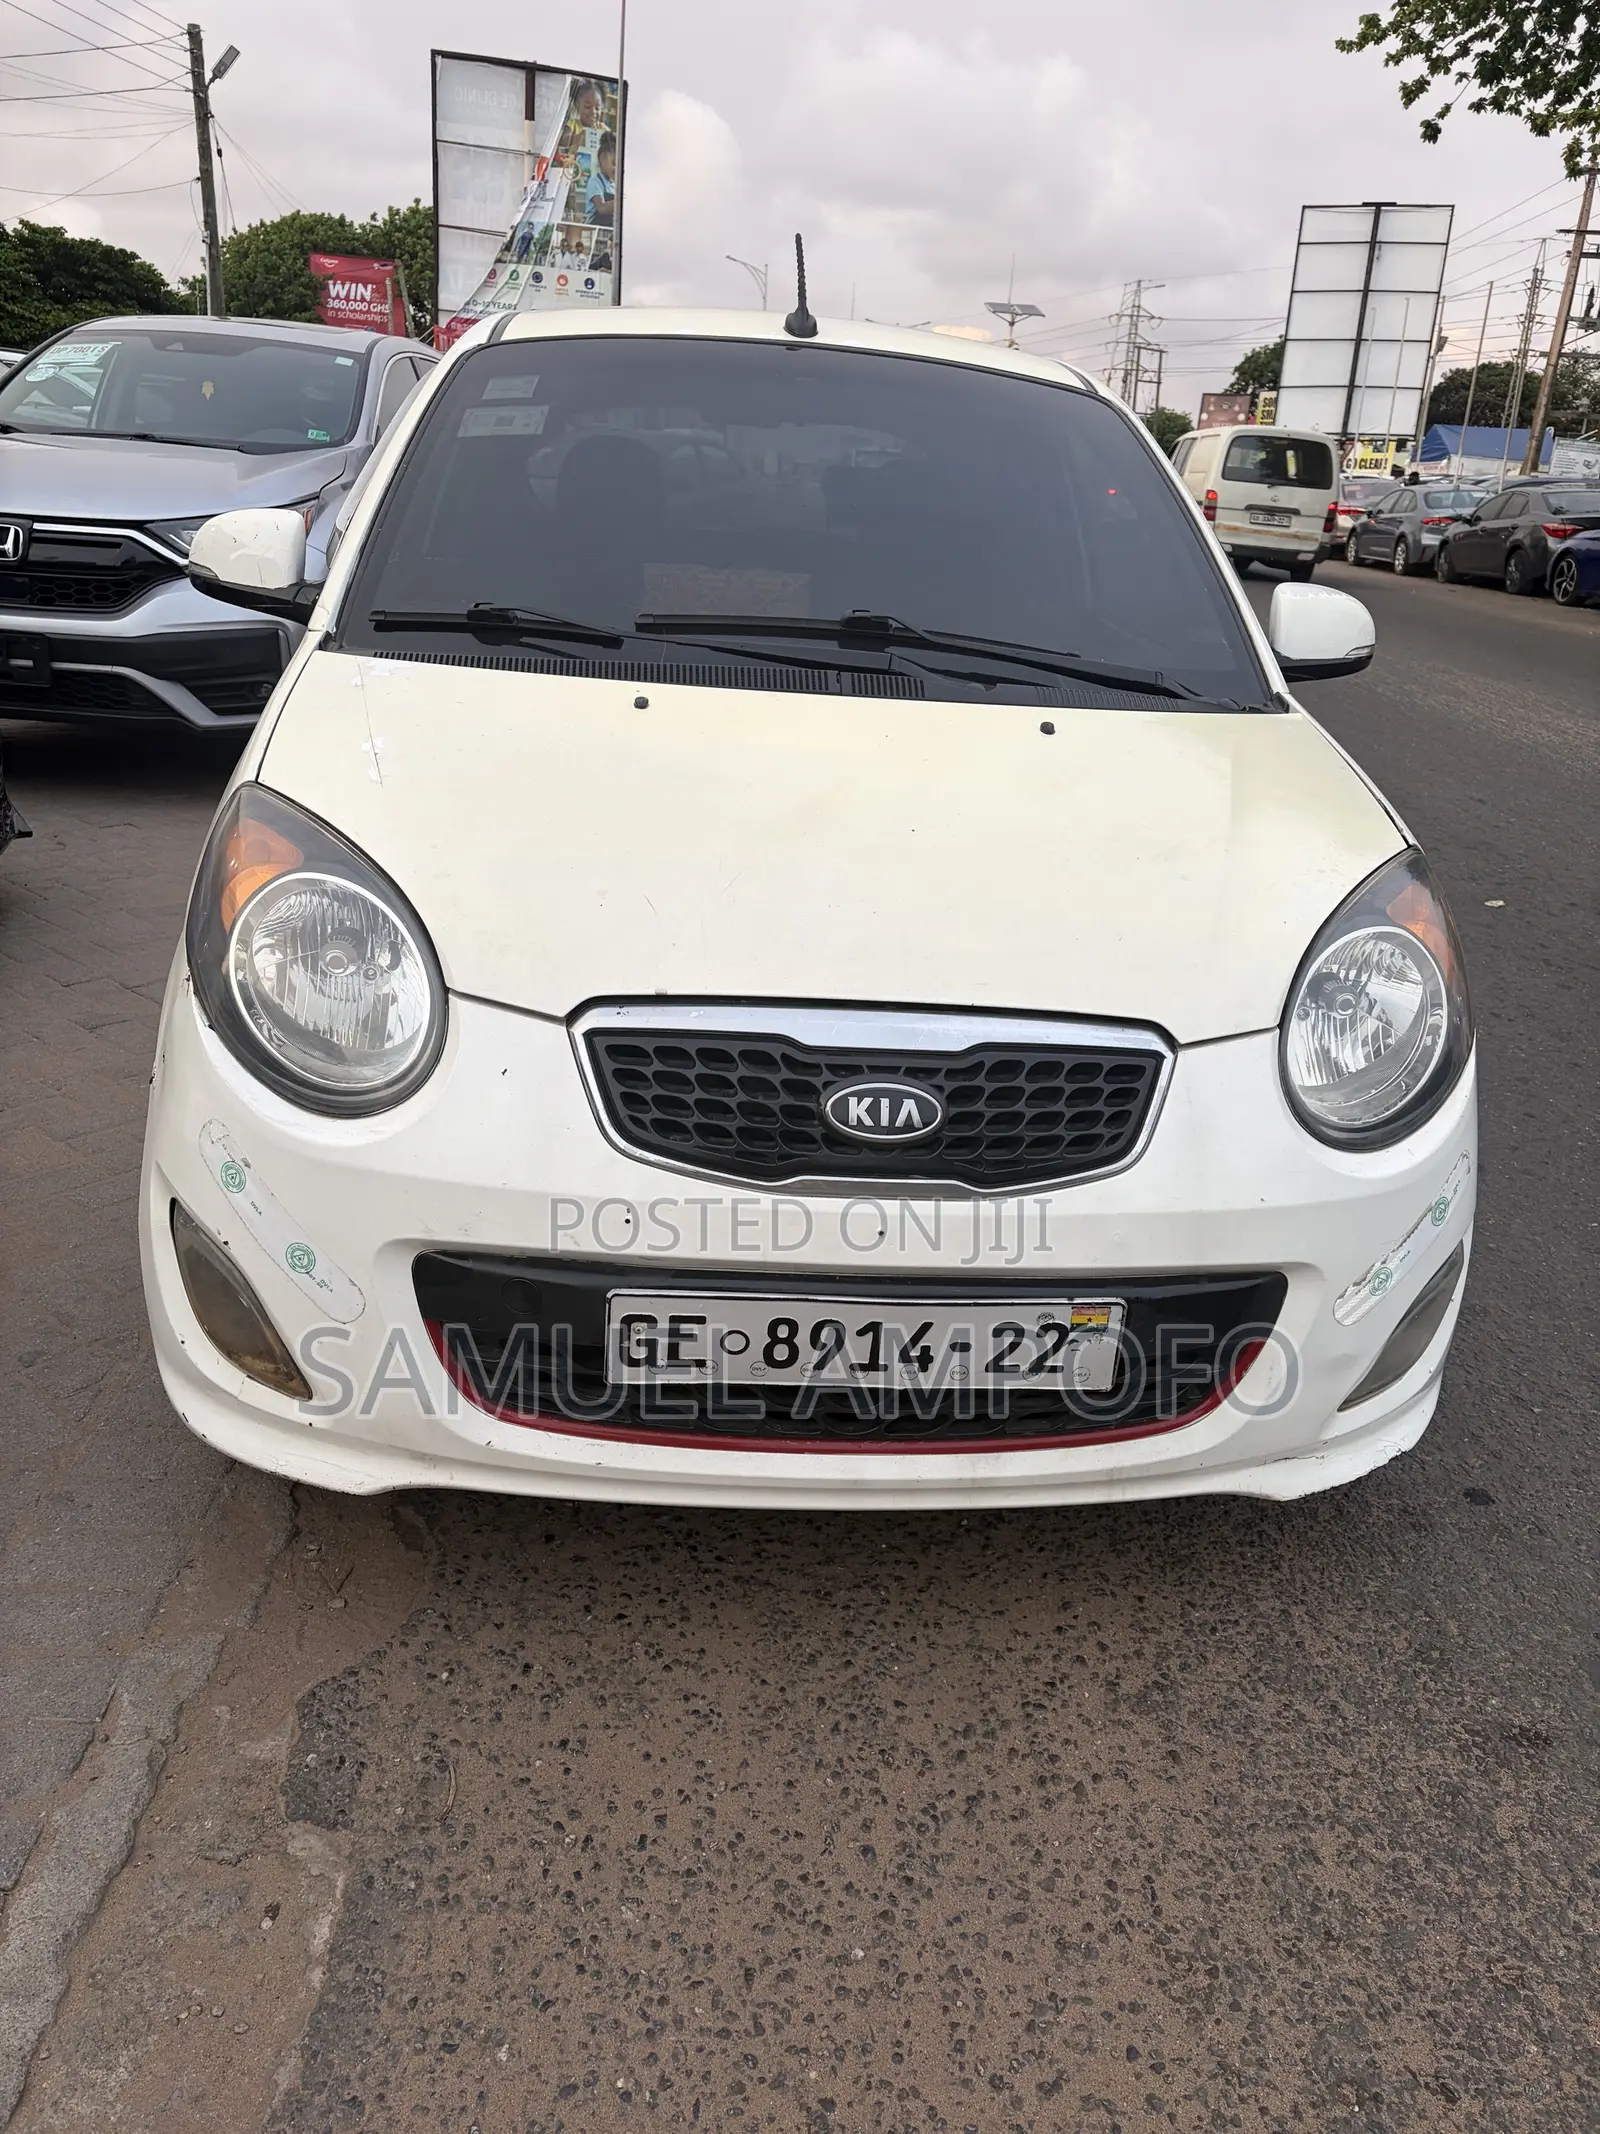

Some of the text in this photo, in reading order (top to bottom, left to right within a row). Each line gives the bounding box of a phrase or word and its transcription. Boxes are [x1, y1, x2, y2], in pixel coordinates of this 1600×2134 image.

[326, 299, 368, 311] 360,000
[491, 301, 518, 310] YEARS
[327, 309, 387, 324] in scholarships
[847, 1096, 925, 1130] KIA
[619, 1313, 707, 1369] GE
